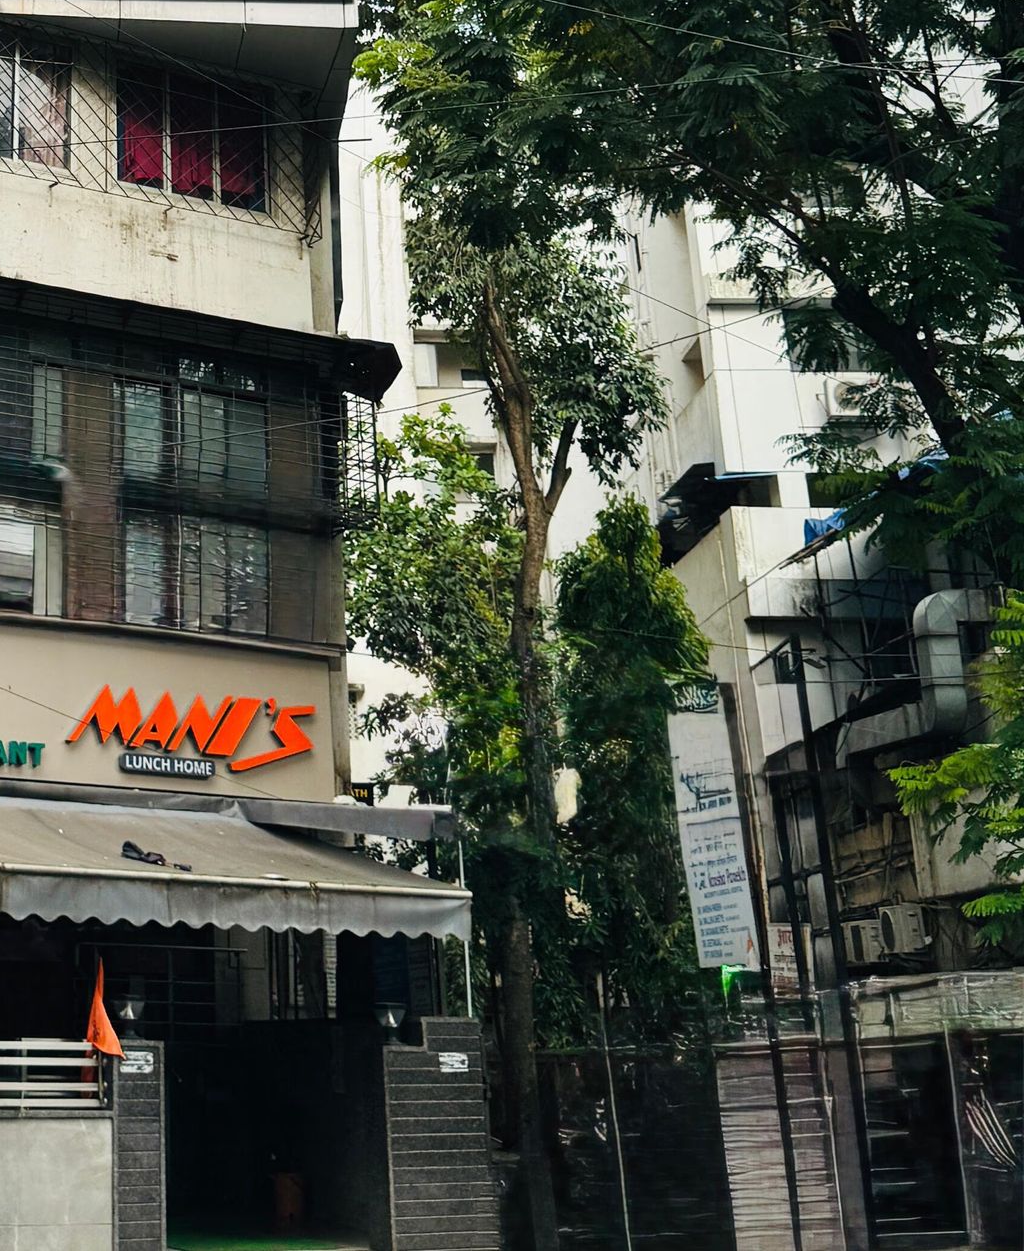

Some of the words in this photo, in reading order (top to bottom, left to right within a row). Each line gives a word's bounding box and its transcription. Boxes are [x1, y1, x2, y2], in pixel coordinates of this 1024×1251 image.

[65, 684, 317, 773] MANI'S
[125, 753, 171, 772] LUNCH
[174, 758, 213, 776] HOME
